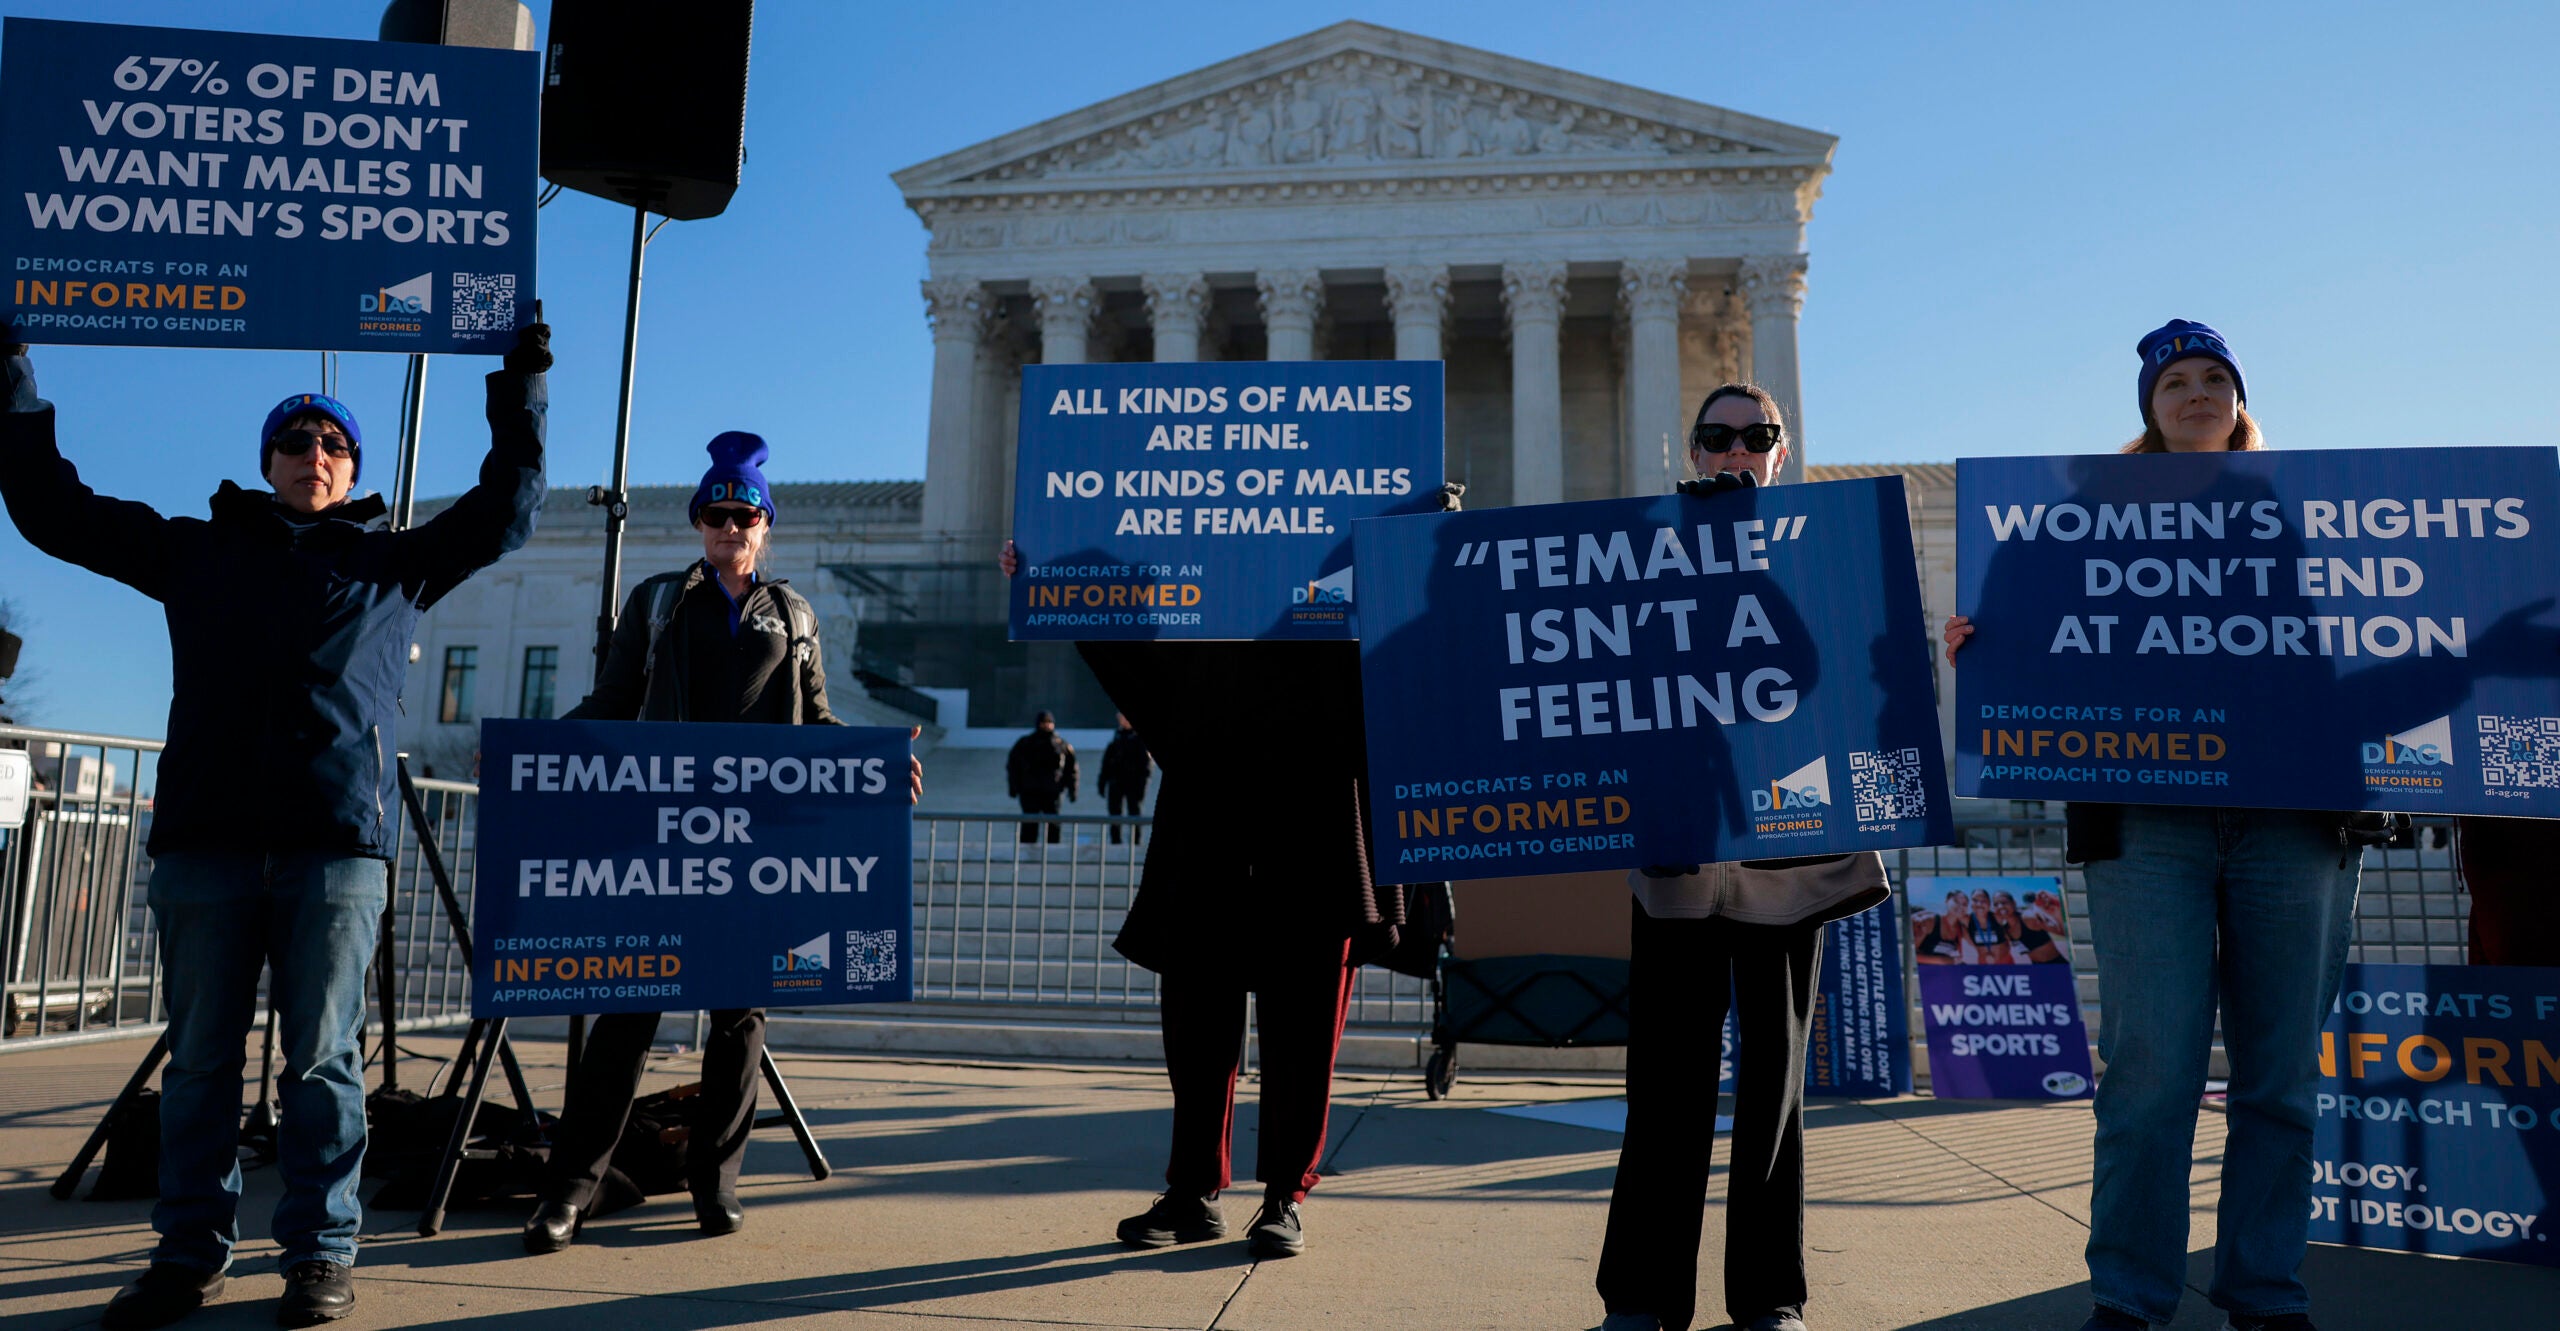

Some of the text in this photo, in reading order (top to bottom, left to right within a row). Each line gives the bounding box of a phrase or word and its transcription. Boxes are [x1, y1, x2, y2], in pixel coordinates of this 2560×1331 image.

[114, 56, 440, 106] 67% OF DEM
[83, 100, 468, 152] VOTERS DON'T
[59, 146, 482, 199] WANT MALES IN
[25, 192, 509, 246] WOMEN'S SPORTS
[16, 257, 247, 277] DEMOCRATS FOR AN
[16, 280, 245, 310] INFORMED
[359, 286, 423, 315] DIAG
[13, 314, 245, 332] APPROACH TO GENDER
[360, 322, 422, 332] INFORMED
[452, 332, 486, 340] di-ag.org
[2154, 335, 2228, 366] DIAG
[283, 395, 350, 422] DIAG
[1049, 385, 1412, 415] ALL KINDS OF MALES
[1146, 424, 1309, 451] ARE FINE.
[711, 482, 762, 507] DIAG
[1047, 468, 1411, 498] NO KINDS OF MALES
[1115, 507, 1334, 535] ARE FEMALE.
[1985, 498, 2529, 541] WOMEN'S RIGHTS
[1454, 516, 1807, 590] "FEMALE"
[1029, 565, 1202, 577] DEMOCRATS FOR AN
[2085, 557, 2423, 597] DON'T END
[1029, 585, 1201, 606] INFORMED
[1292, 580, 1345, 604] DIAG
[1027, 613, 1201, 625] APPROACH TO GENDER
[1506, 594, 1780, 664] ISN'T A
[2050, 615, 2467, 657] AT ABORTION
[1500, 667, 1797, 740] FEELING
[1982, 704, 2225, 723] DEMOCRATS FOR AN
[1983, 730, 2225, 760] INFORMED
[2362, 734, 2442, 766] DIAG
[511, 754, 886, 794] FEMALE SPORTS
[1395, 769, 1627, 799] DEMOCRATS FOR AN
[1980, 765, 2228, 786] APPROACH TO GENDER
[2365, 775, 2444, 787] INFORMED
[1751, 779, 1821, 812] DIAG
[2484, 788, 2530, 799] di-ag.org
[658, 807, 753, 844] FOR
[1398, 796, 1630, 838] INFORMED
[1755, 819, 1823, 833] INFORMED
[1858, 823, 1896, 833] di-ag.org
[1400, 834, 1635, 863] APPROACH TO GENDER
[519, 857, 878, 897] FEMALES ONLY
[495, 934, 681, 950] DEMOCRATS FOR AN
[1838, 919, 1851, 970] PLAYING
[1854, 929, 1866, 961] THEM
[1869, 930, 1882, 958] TWO
[495, 955, 680, 982] INFORMED
[772, 947, 824, 972] DIAG
[492, 984, 681, 1002] APPROACH TO GENDER
[773, 978, 823, 988] INFORMED
[1841, 972, 1853, 1006] FIELD
[1856, 964, 1870, 1017] GETTING
[1871, 959, 1885, 1001] LITTLE
[1963, 975, 2032, 996] SAVE
[1843, 1008, 1854, 1025] BY
[1931, 1003, 2070, 1026] WOMEN'S
[1844, 1025, 1855, 1035] A
[1859, 1018, 1872, 1045] RUN
[1844, 1036, 1857, 1071] MALE
[1951, 1034, 2060, 1056] SPORTS
[1861, 1047, 1874, 1082] OVER
[1877, 1050, 1892, 1091] DON'T
[2481, 1103, 2537, 1129] TO
[2351, 1200, 2546, 1241] IDEOLOGY.
